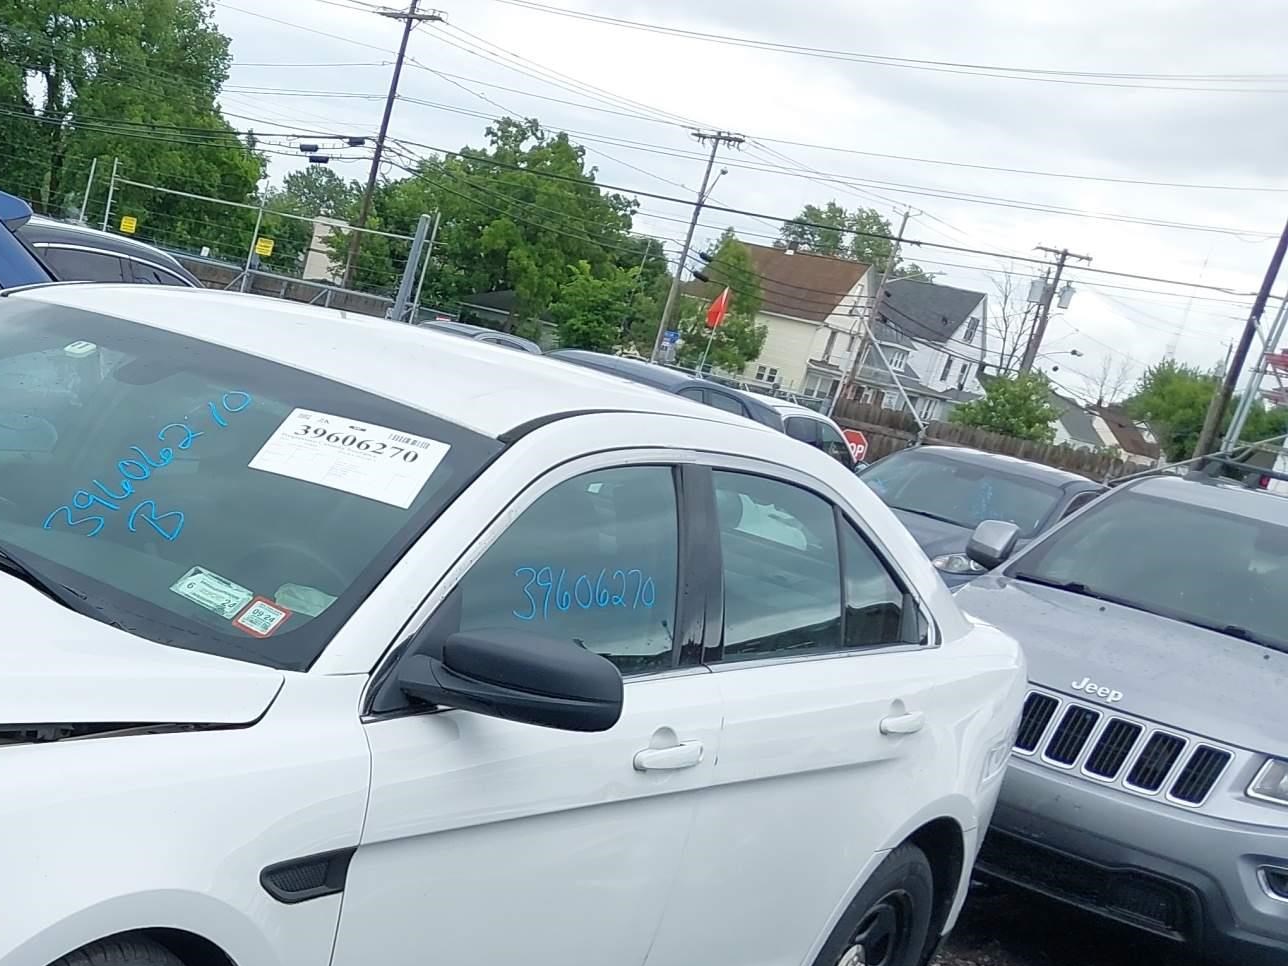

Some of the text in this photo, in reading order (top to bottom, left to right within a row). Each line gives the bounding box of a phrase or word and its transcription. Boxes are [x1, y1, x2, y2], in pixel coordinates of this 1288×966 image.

[293, 424, 419, 463] 39606270
[849, 442, 865, 457] OP
[128, 499, 184, 541] B
[513, 566, 656, 622] 39606270
[1071, 677, 1124, 703] Jeep
